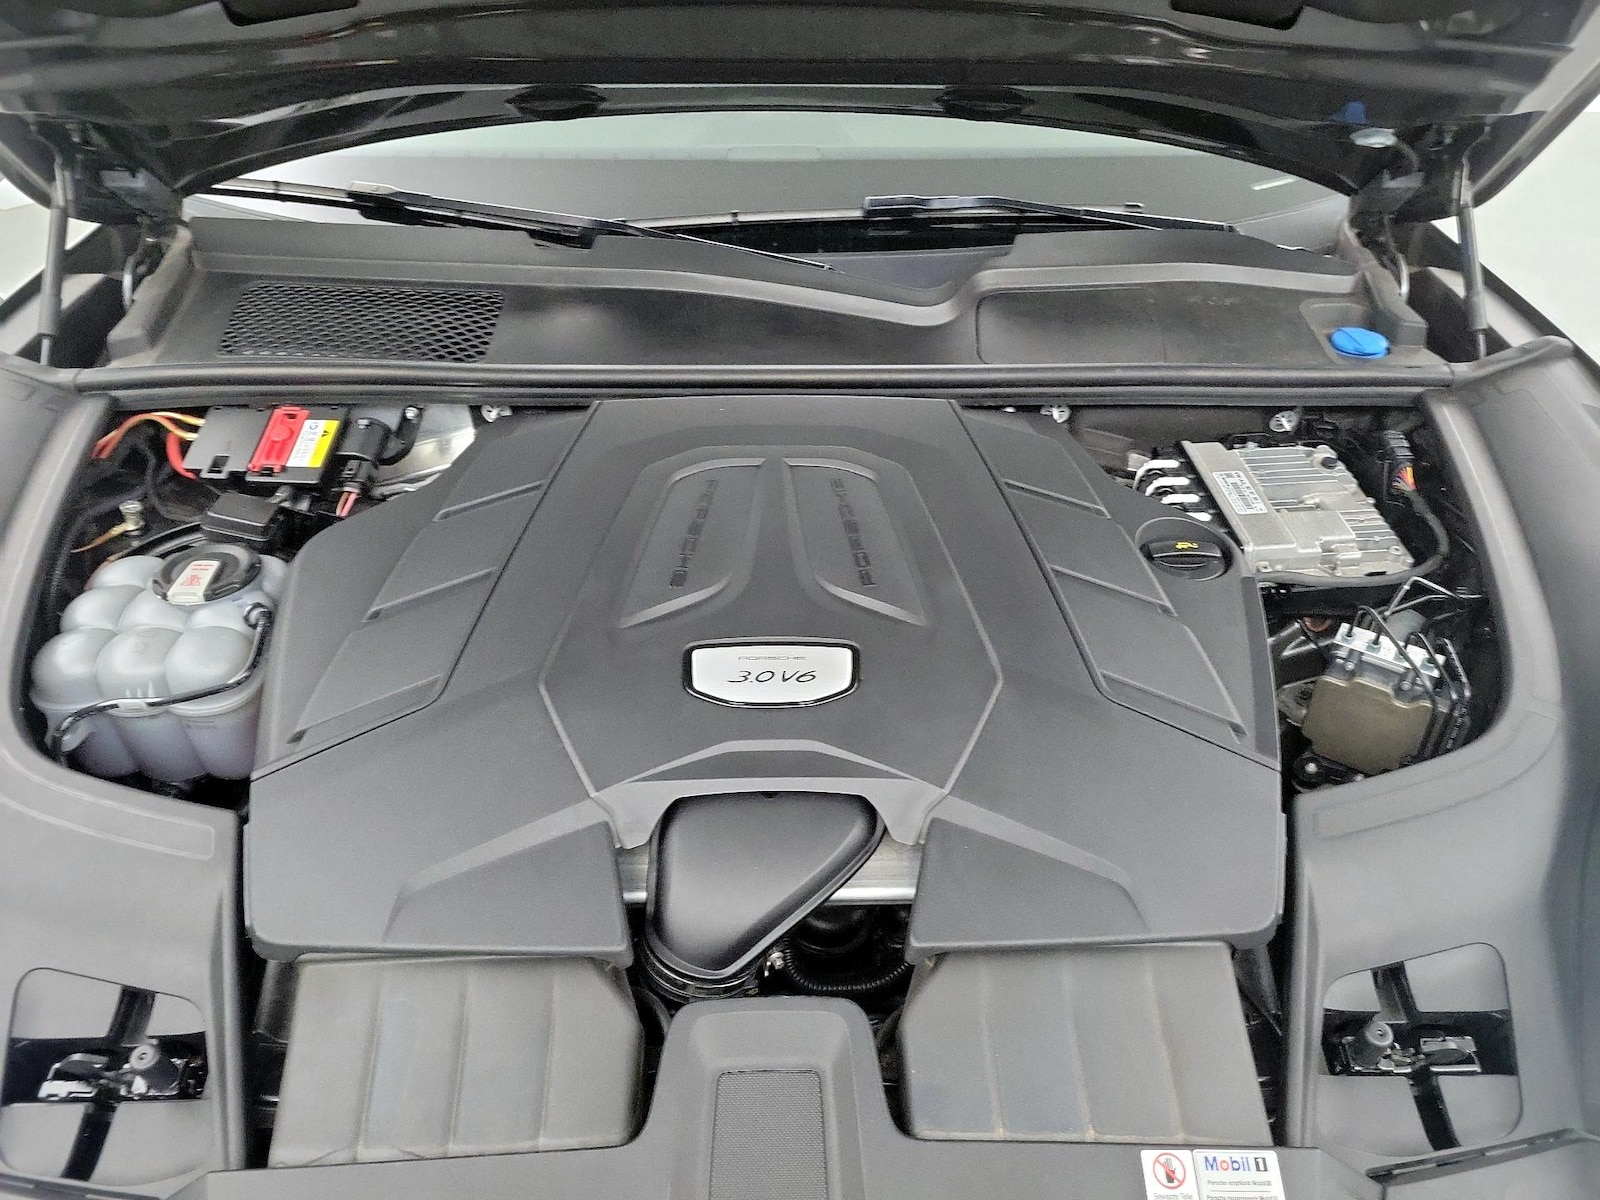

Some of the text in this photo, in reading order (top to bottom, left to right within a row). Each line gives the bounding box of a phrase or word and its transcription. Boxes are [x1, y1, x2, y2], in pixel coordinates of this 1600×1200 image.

[727, 670, 817, 683] 3.0 V6
[1203, 1155, 1269, 1172] Mobil 1
